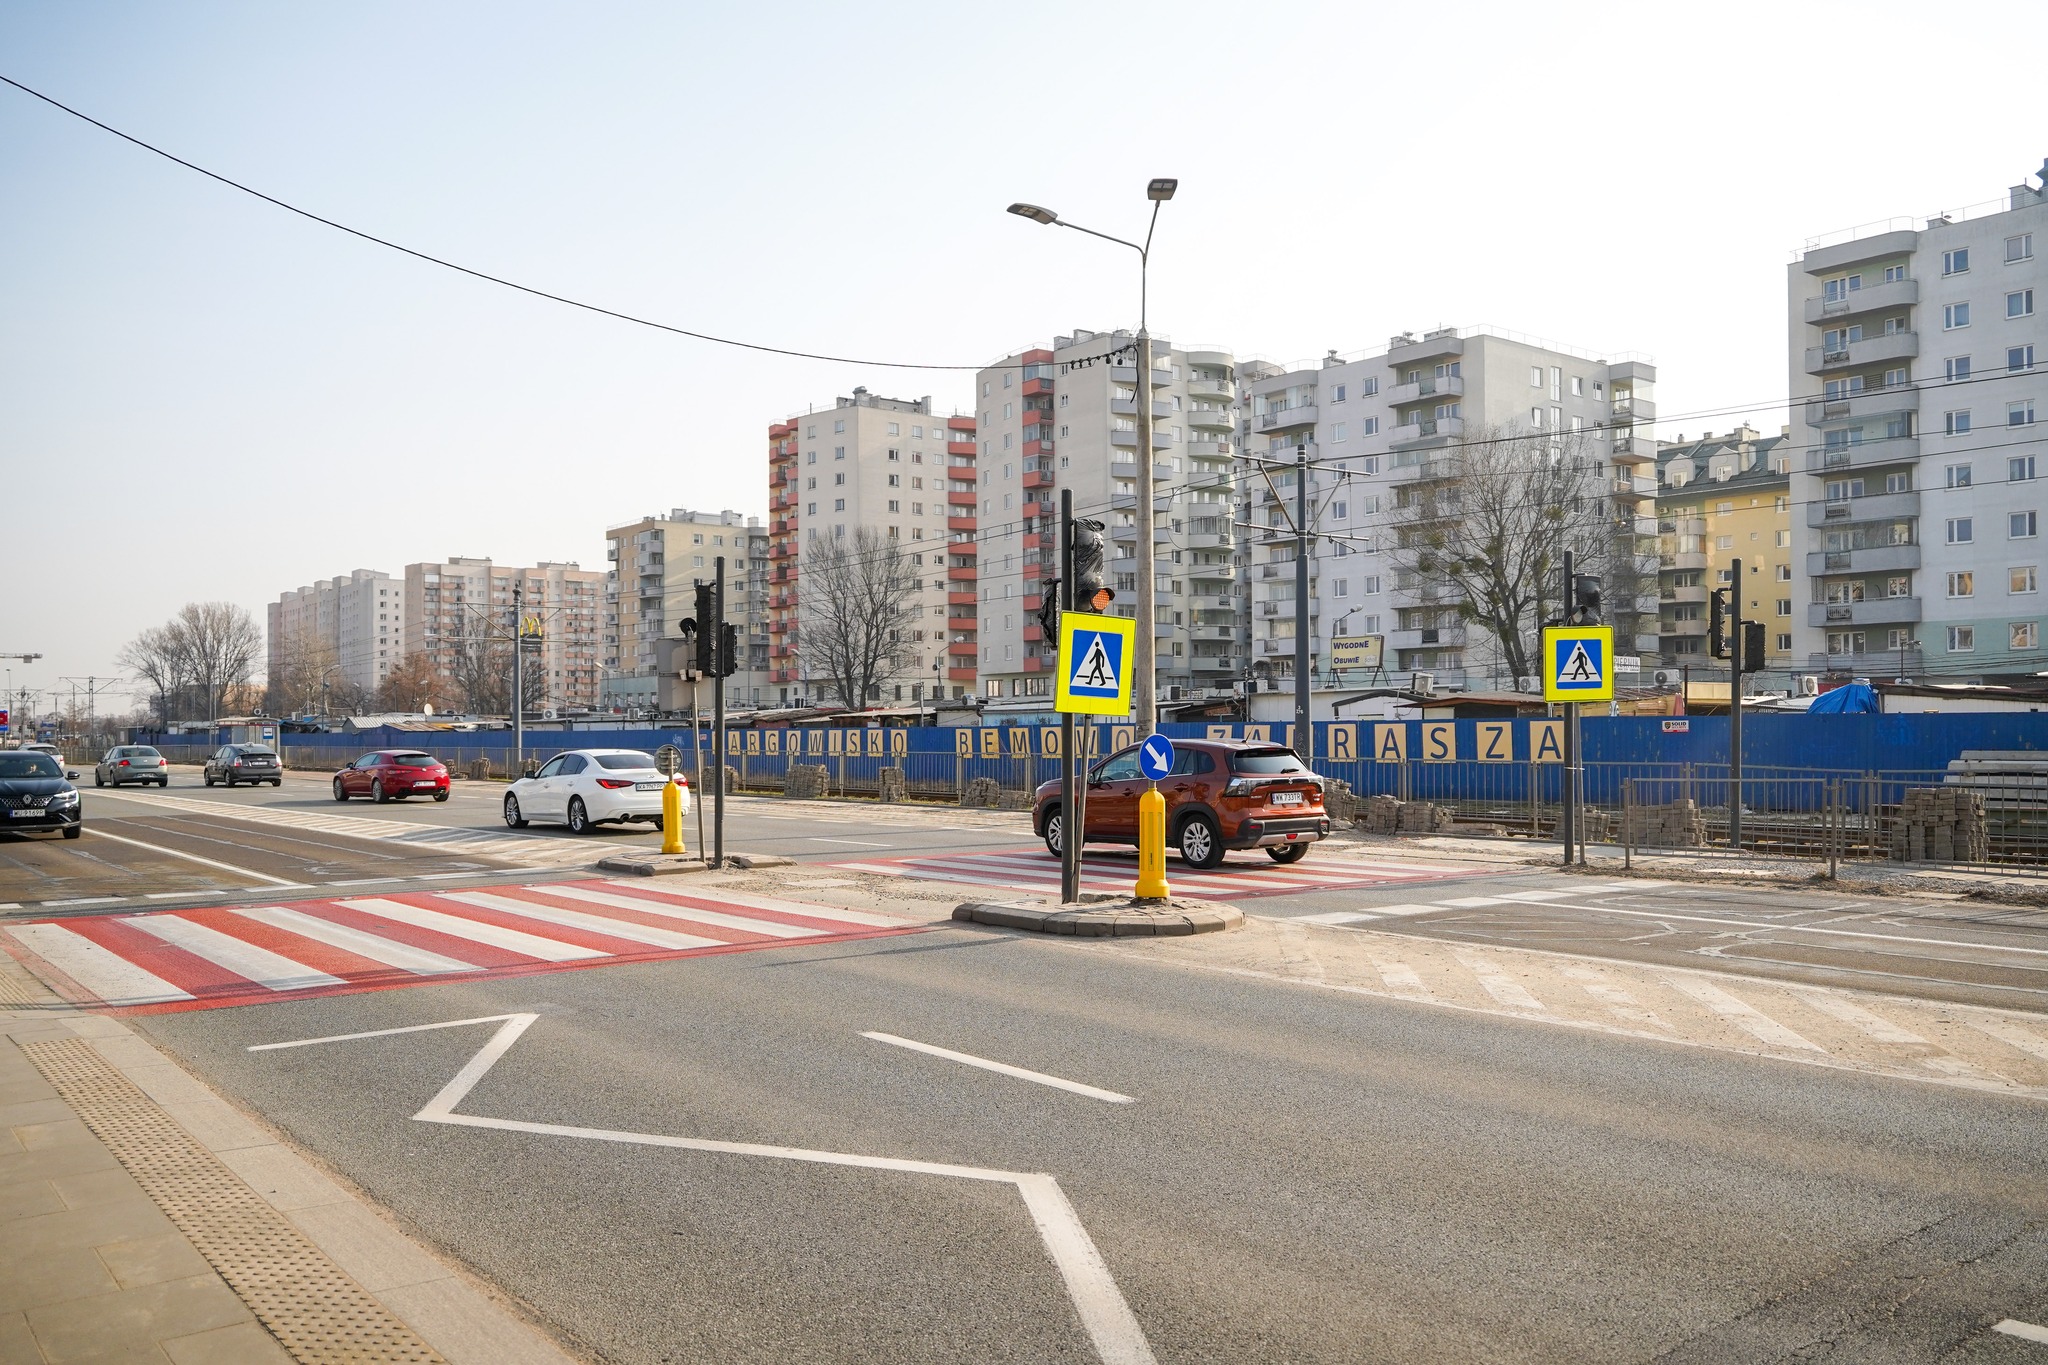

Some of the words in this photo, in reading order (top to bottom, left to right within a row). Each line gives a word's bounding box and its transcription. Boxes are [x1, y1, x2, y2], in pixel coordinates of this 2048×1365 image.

[1333, 640, 1369, 650] WYGODNE
[1333, 656, 1360, 664] OBUWIE
[714, 732, 905, 754] ARGOWISKO
[1213, 725, 1562, 760] RASZA
